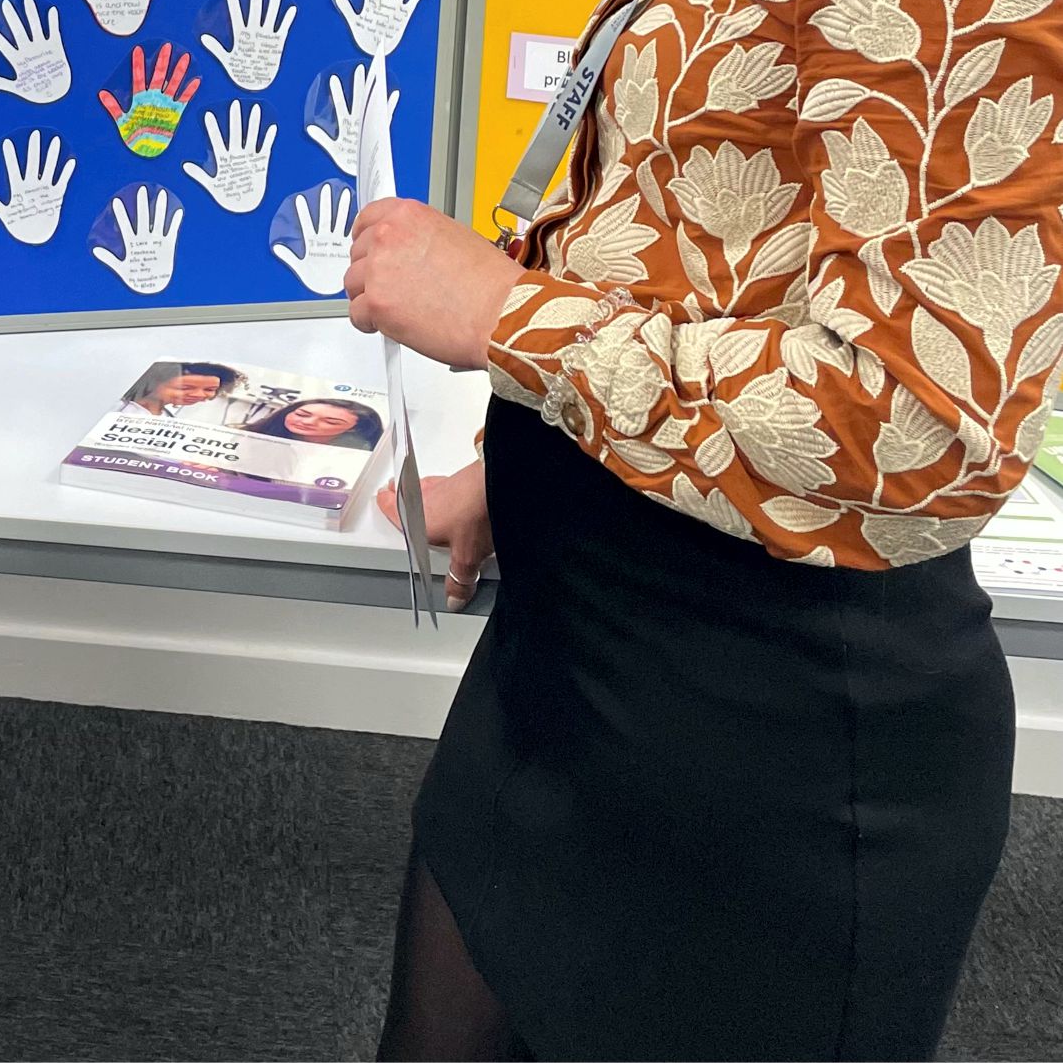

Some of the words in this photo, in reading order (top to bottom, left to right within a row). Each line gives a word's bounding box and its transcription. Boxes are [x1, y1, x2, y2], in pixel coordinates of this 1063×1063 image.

[556, 66, 595, 131] STAFF
[100, 433, 177, 450] Social
[181, 444, 240, 463] Care
[109, 423, 186, 440] Health
[191, 436, 238, 451] and
[80, 454, 165, 473] STUDENT
[165, 465, 219, 484] BOOK
